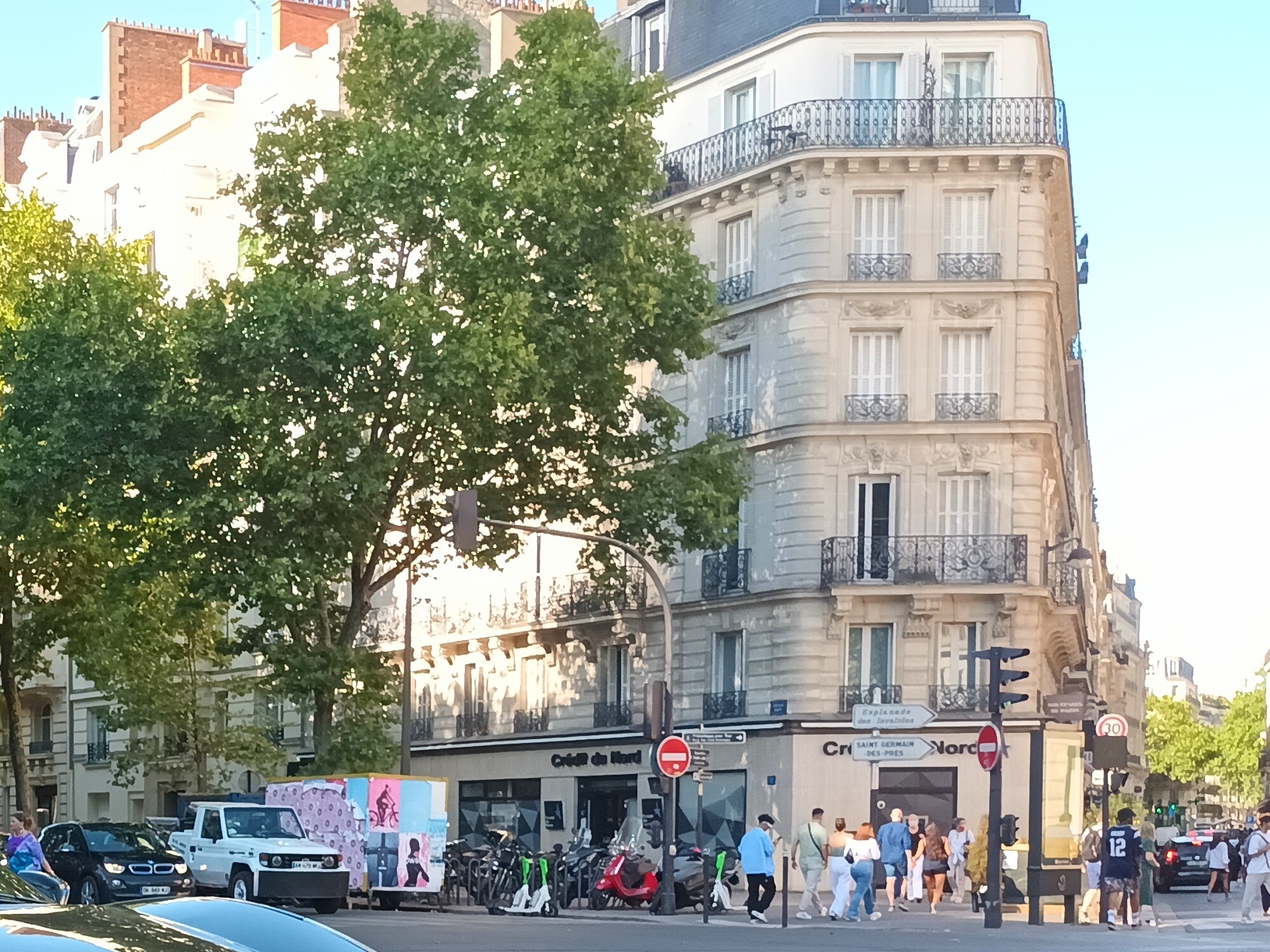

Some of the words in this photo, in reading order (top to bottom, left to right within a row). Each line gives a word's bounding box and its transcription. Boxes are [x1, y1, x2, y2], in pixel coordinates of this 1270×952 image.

[1104, 723, 1121, 735] 30
[880, 741, 915, 749] GERMAIN
[1109, 837, 1127, 857] 12
